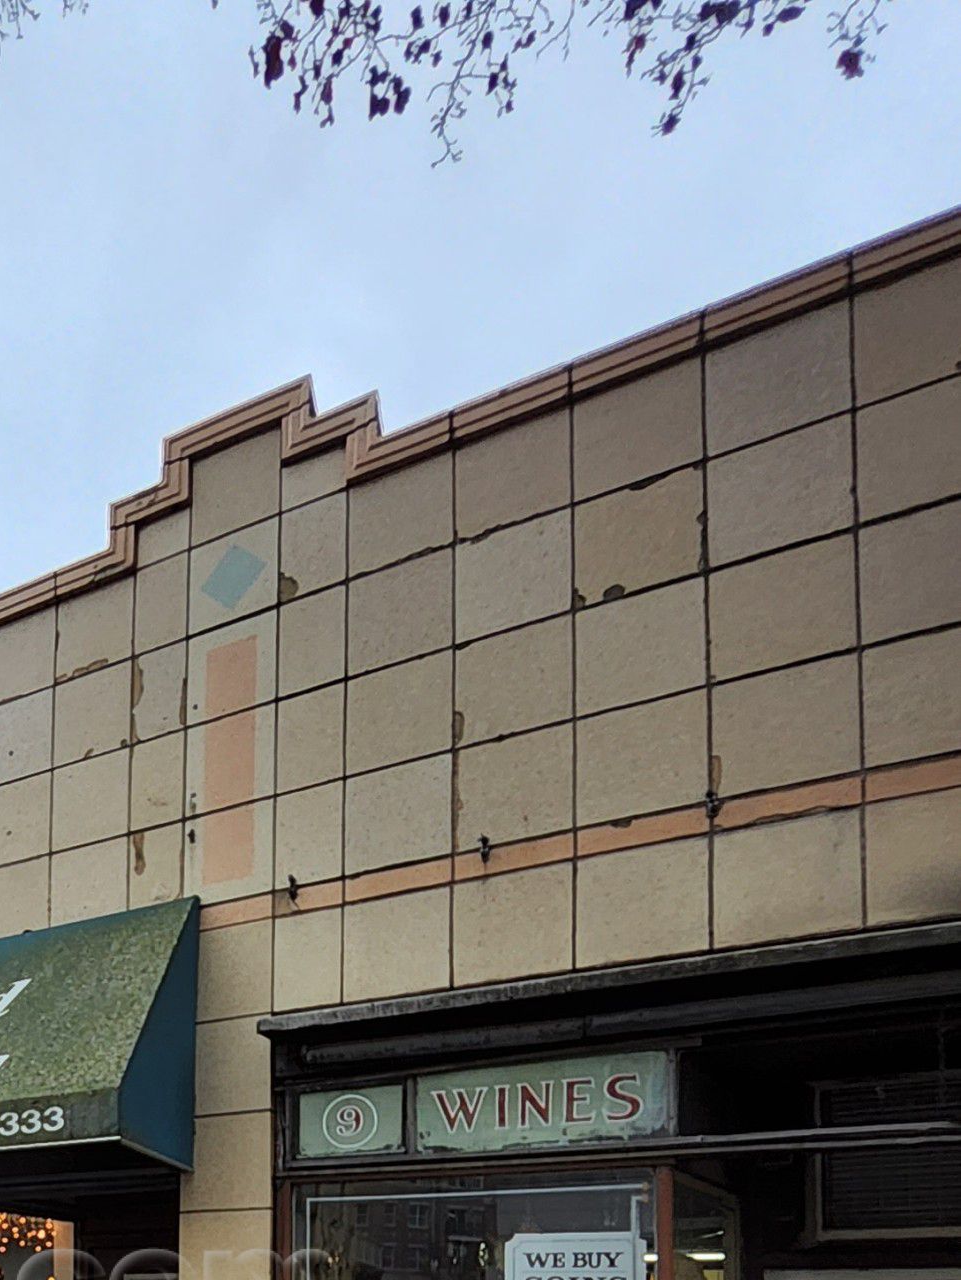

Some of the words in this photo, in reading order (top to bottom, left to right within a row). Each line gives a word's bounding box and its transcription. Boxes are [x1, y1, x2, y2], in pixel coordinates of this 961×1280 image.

[431, 1073, 644, 1134] WINES
[337, 1105, 364, 1136] 9
[523, 1252, 565, 1269] WE
[572, 1251, 624, 1269] BUY
